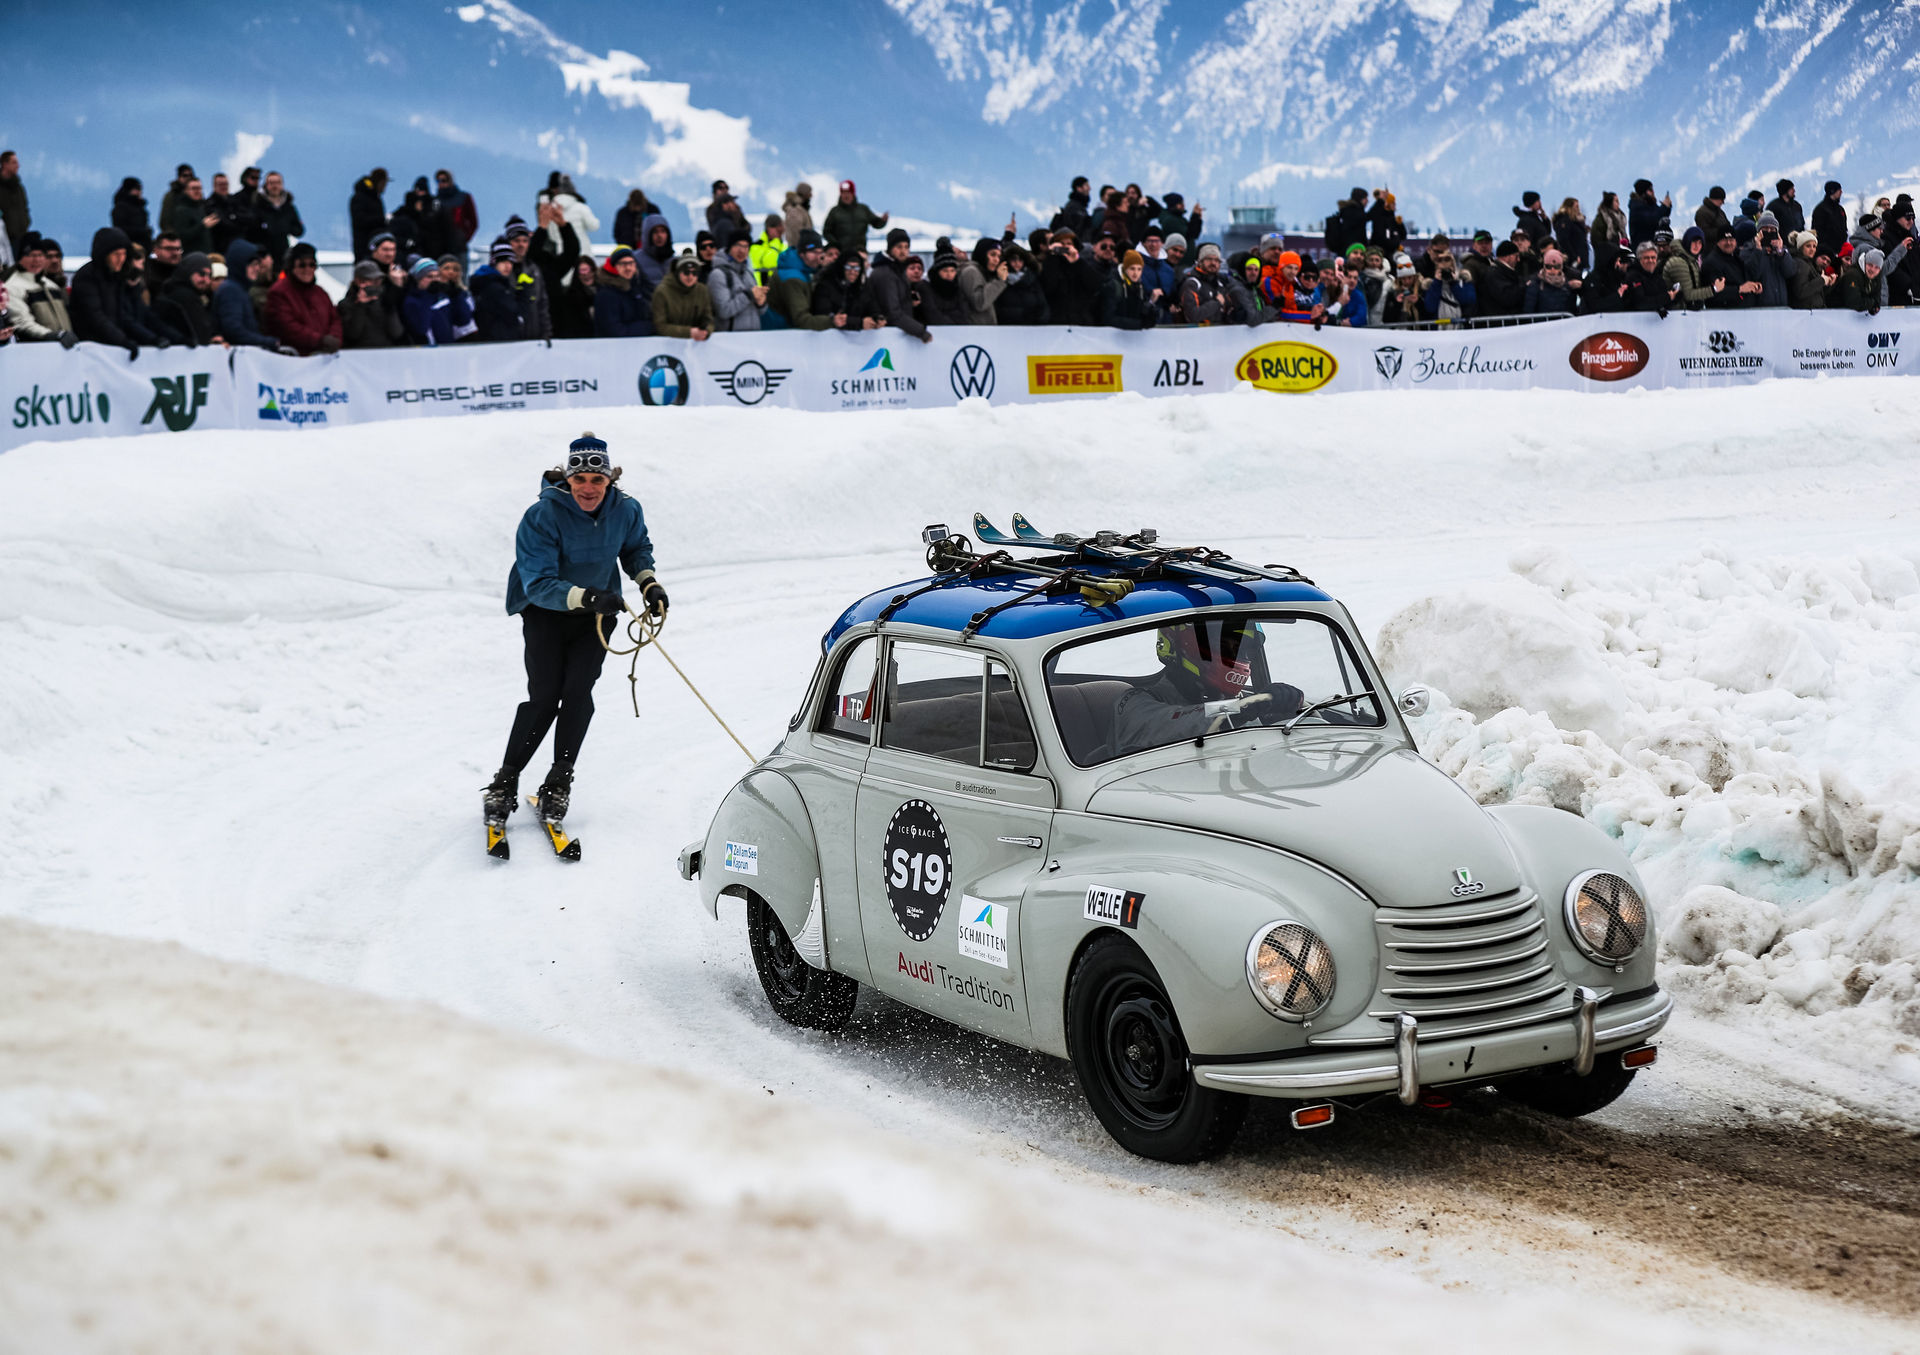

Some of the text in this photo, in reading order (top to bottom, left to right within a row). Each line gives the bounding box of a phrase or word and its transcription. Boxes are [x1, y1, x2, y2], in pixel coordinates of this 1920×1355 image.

[1410, 345, 1538, 383] Backhausen
[1582, 350, 1638, 366] Pinzgau Milch
[1679, 356, 1763, 370] WIENINGER BIER
[1793, 348, 1856, 359] Die Energie für ein
[1867, 353, 1898, 368] OMV
[1035, 362, 1114, 386] PIRELLI
[1153, 358, 1204, 387] ABL
[1261, 357, 1323, 379] RAUCH
[1800, 361, 1831, 370] besseres
[386, 379, 598, 403] PORSCHE DESIGN
[737, 377, 764, 388] MINI
[831, 377, 917, 395] SCHMITTEN
[141, 373, 210, 432] RUF
[277, 387, 304, 405] Zell
[323, 387, 349, 404] See
[281, 406, 327, 428] Kaprun
[850, 698, 869, 723] TR
[898, 825, 935, 838] ICE RACE
[733, 857, 749, 871] Kaprun
[890, 848, 944, 895] S19
[959, 926, 1006, 952] SCHMITTEN
[898, 951, 1015, 1012] Audi Tradition
